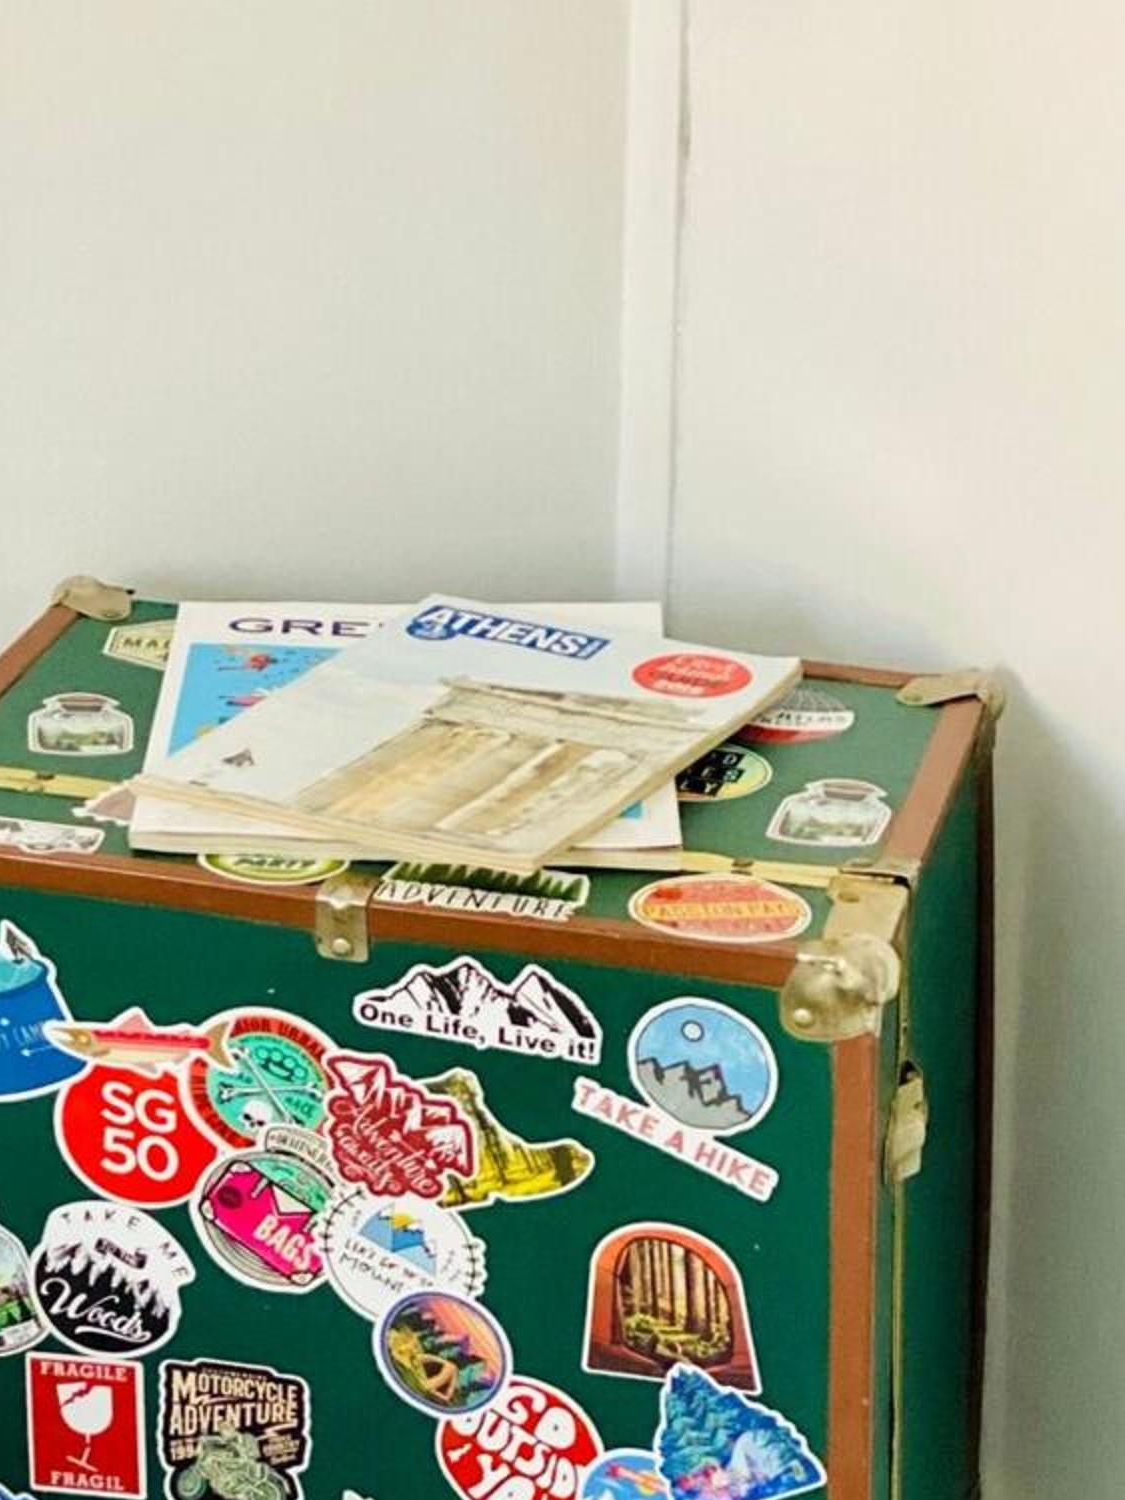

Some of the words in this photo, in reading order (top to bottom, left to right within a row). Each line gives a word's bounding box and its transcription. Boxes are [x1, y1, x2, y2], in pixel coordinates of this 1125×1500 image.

[377, 883, 575, 917] ADVENTURE
[360, 1004, 413, 1027] One
[426, 1013, 485, 1044] Life,
[498, 1026, 555, 1052] Live
[568, 1040, 595, 1059] it!
[100, 1081, 177, 1132] SG
[100, 1127, 179, 1181] 50
[578, 1084, 660, 1138] TAKE
[664, 1131, 684, 1153] A
[695, 1141, 771, 1195] HIKE
[254, 1215, 315, 1266] BAGS
[40, 1277, 152, 1341] Woods
[40, 1361, 128, 1381] FRAGILE
[172, 1369, 299, 1406] MOTORCYCLE
[169, 1400, 299, 1436] ADVENTURE
[51, 1470, 124, 1491] FRAGIL
